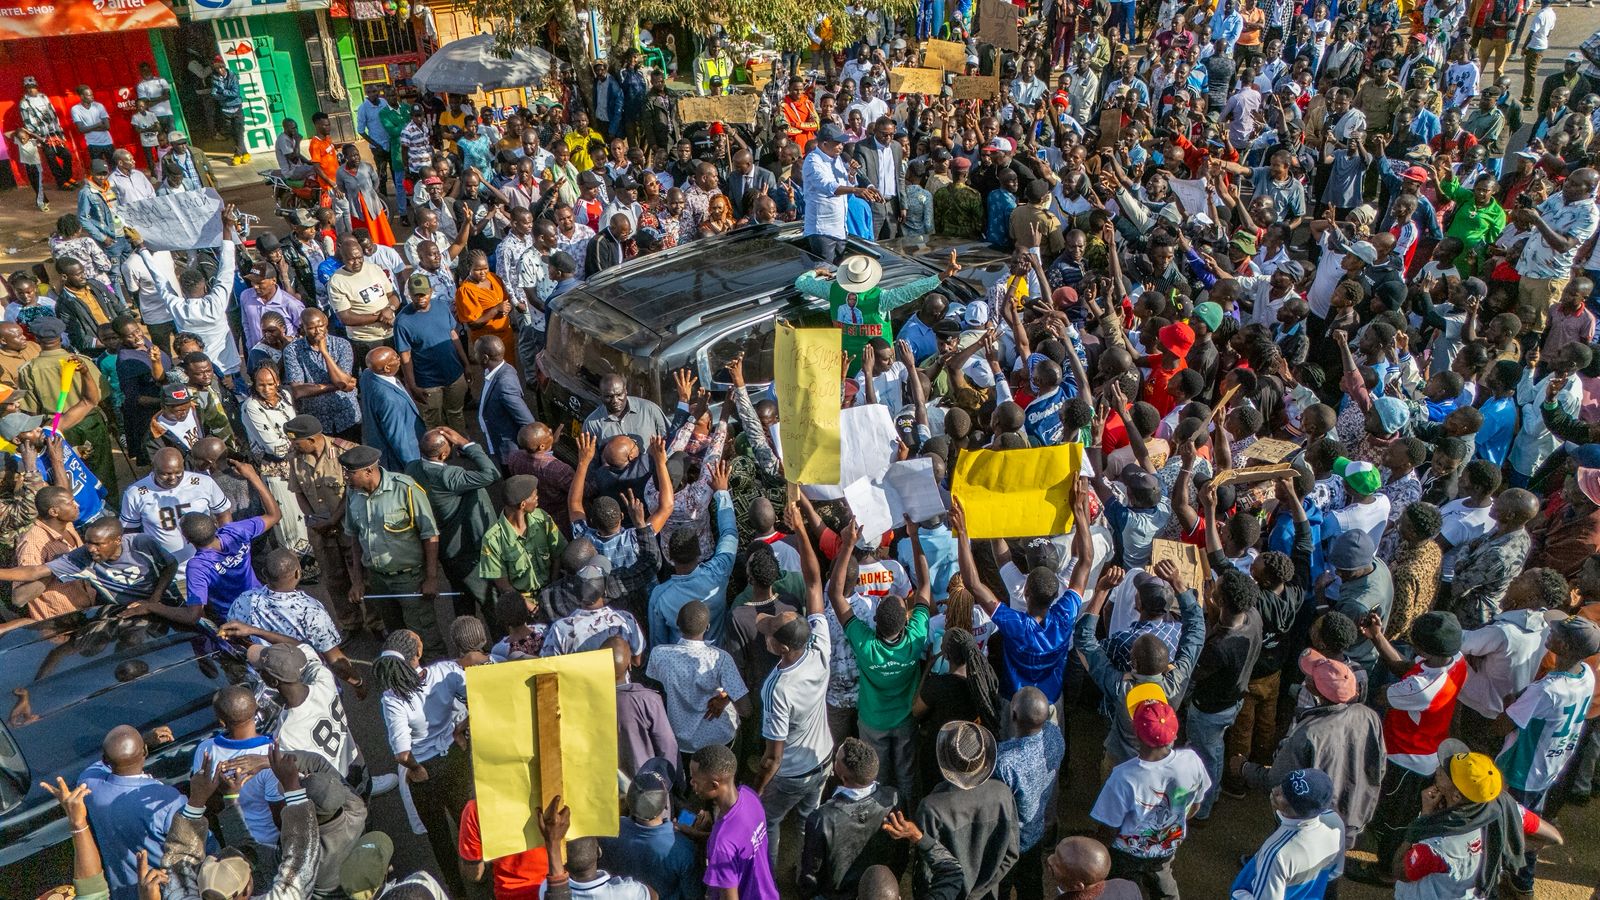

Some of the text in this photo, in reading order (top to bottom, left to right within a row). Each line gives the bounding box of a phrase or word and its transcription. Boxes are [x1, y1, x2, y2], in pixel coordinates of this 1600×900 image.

[27, 5, 55, 15] SHOP
[860, 324, 883, 336] FIRE
[857, 570, 894, 586] HOMES
